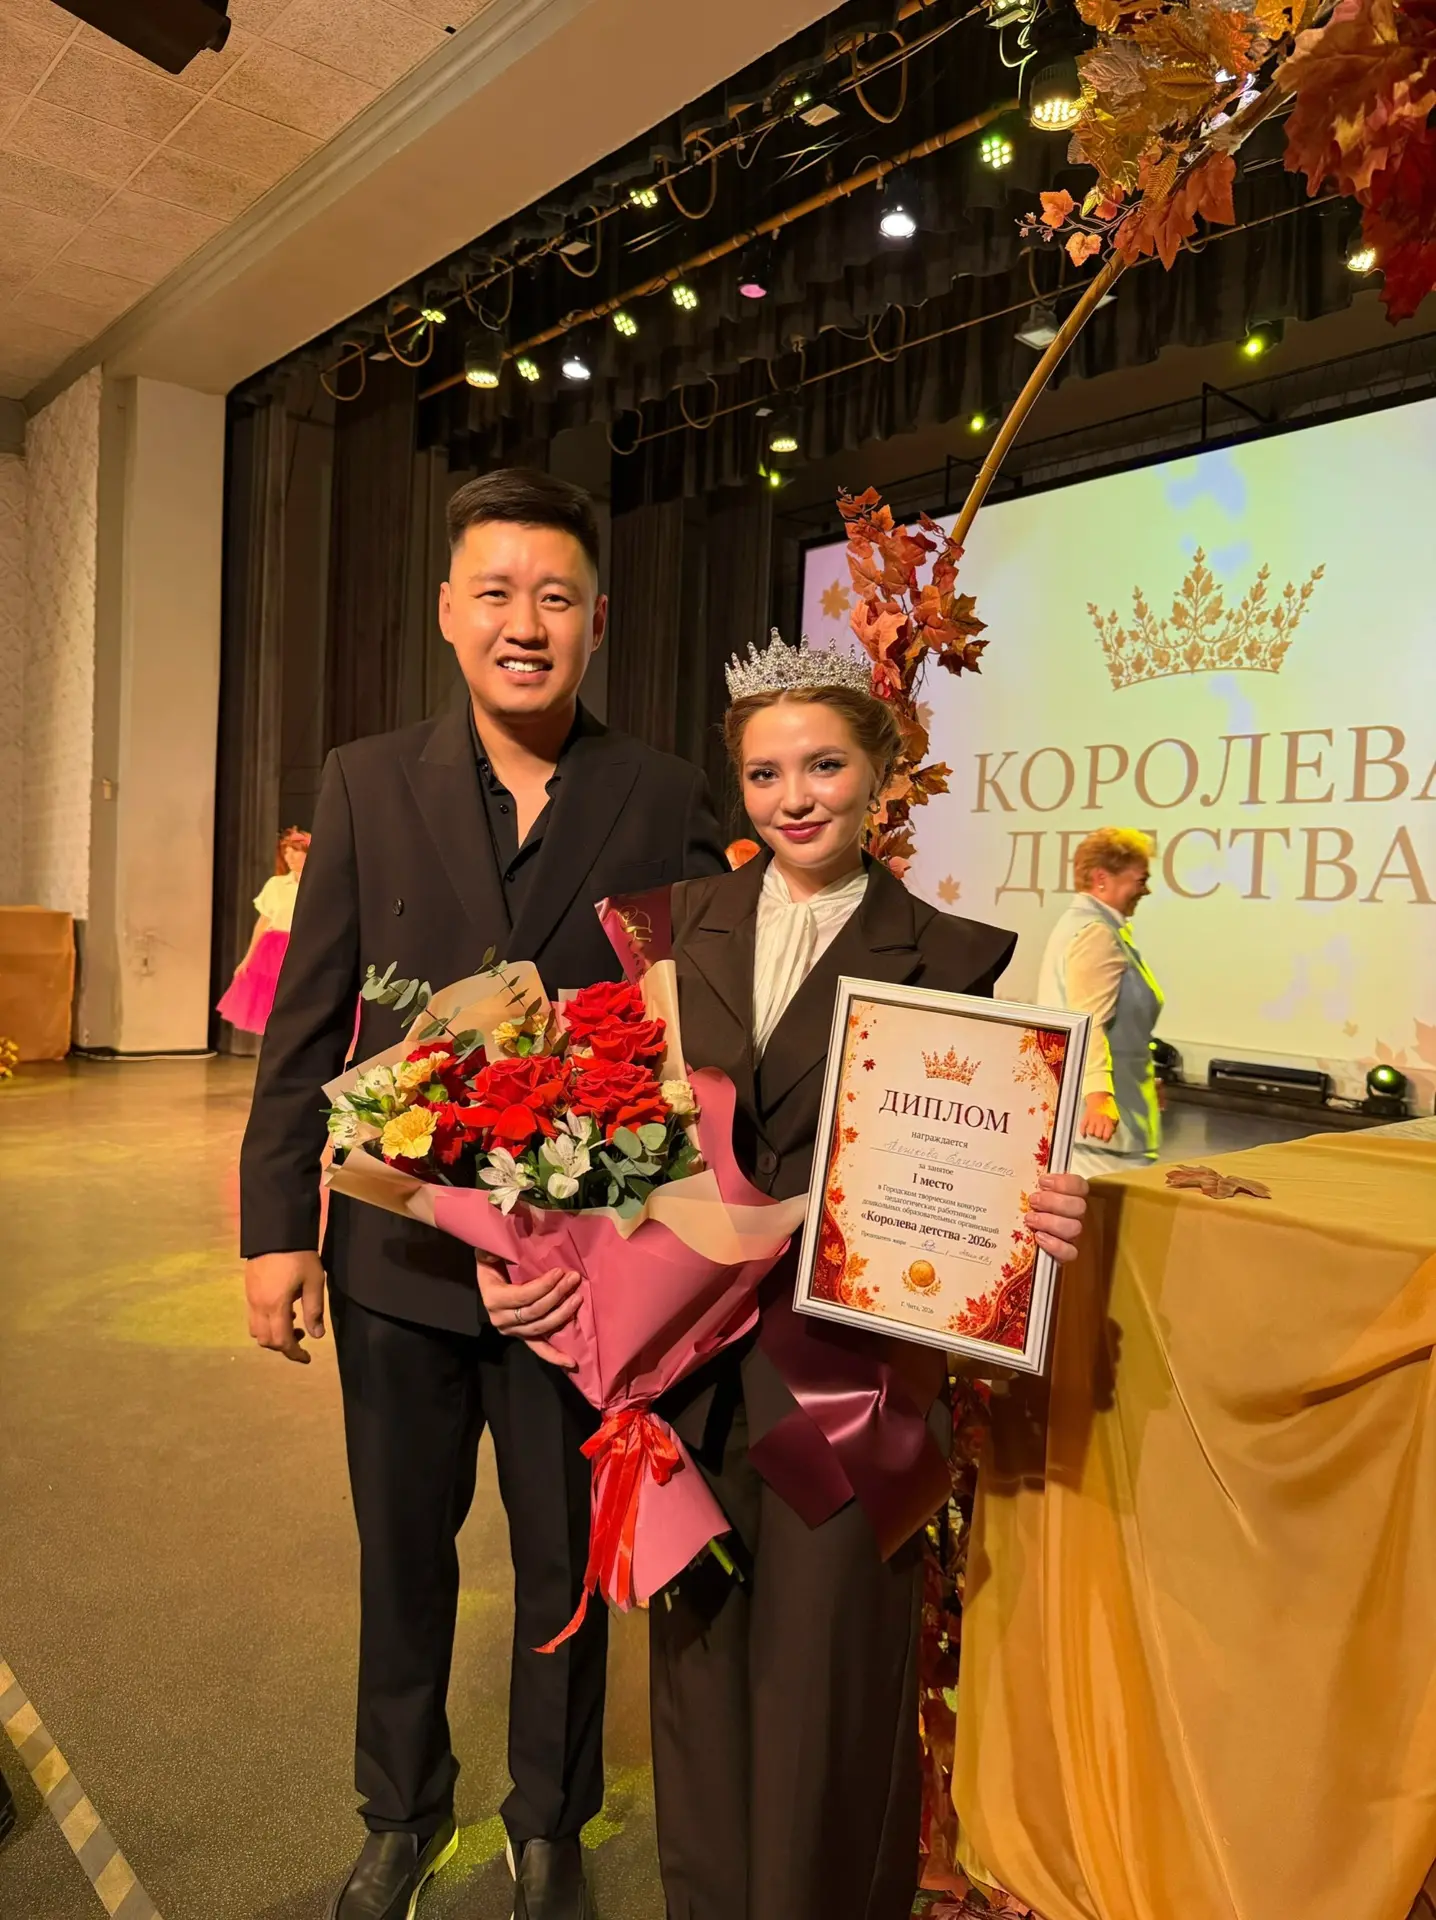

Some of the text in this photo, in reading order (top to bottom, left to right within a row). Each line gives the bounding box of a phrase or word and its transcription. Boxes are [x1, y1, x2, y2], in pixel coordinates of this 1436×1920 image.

[970, 725, 1436, 813] КОРОЛЕВ
[994, 825, 1436, 908] ДЕСТВА
[878, 1088, 1011, 1134] ДИПЛОМ
[911, 1131, 969, 1149] награждается
[919, 1177, 954, 1192] место
[927, 1164, 954, 1175] занятое
[883, 1184, 917, 1198] Городском
[918, 1193, 956, 1206] творческом
[957, 1201, 987, 1213] конкурсе
[885, 1195, 977, 1220] педагогических работников
[861, 1210, 917, 1231] «Королева
[919, 1226, 961, 1241] детства
[968, 1233, 997, 1250] 2026»
[862, 1199, 999, 1234] дошкольных образовательных организаций
